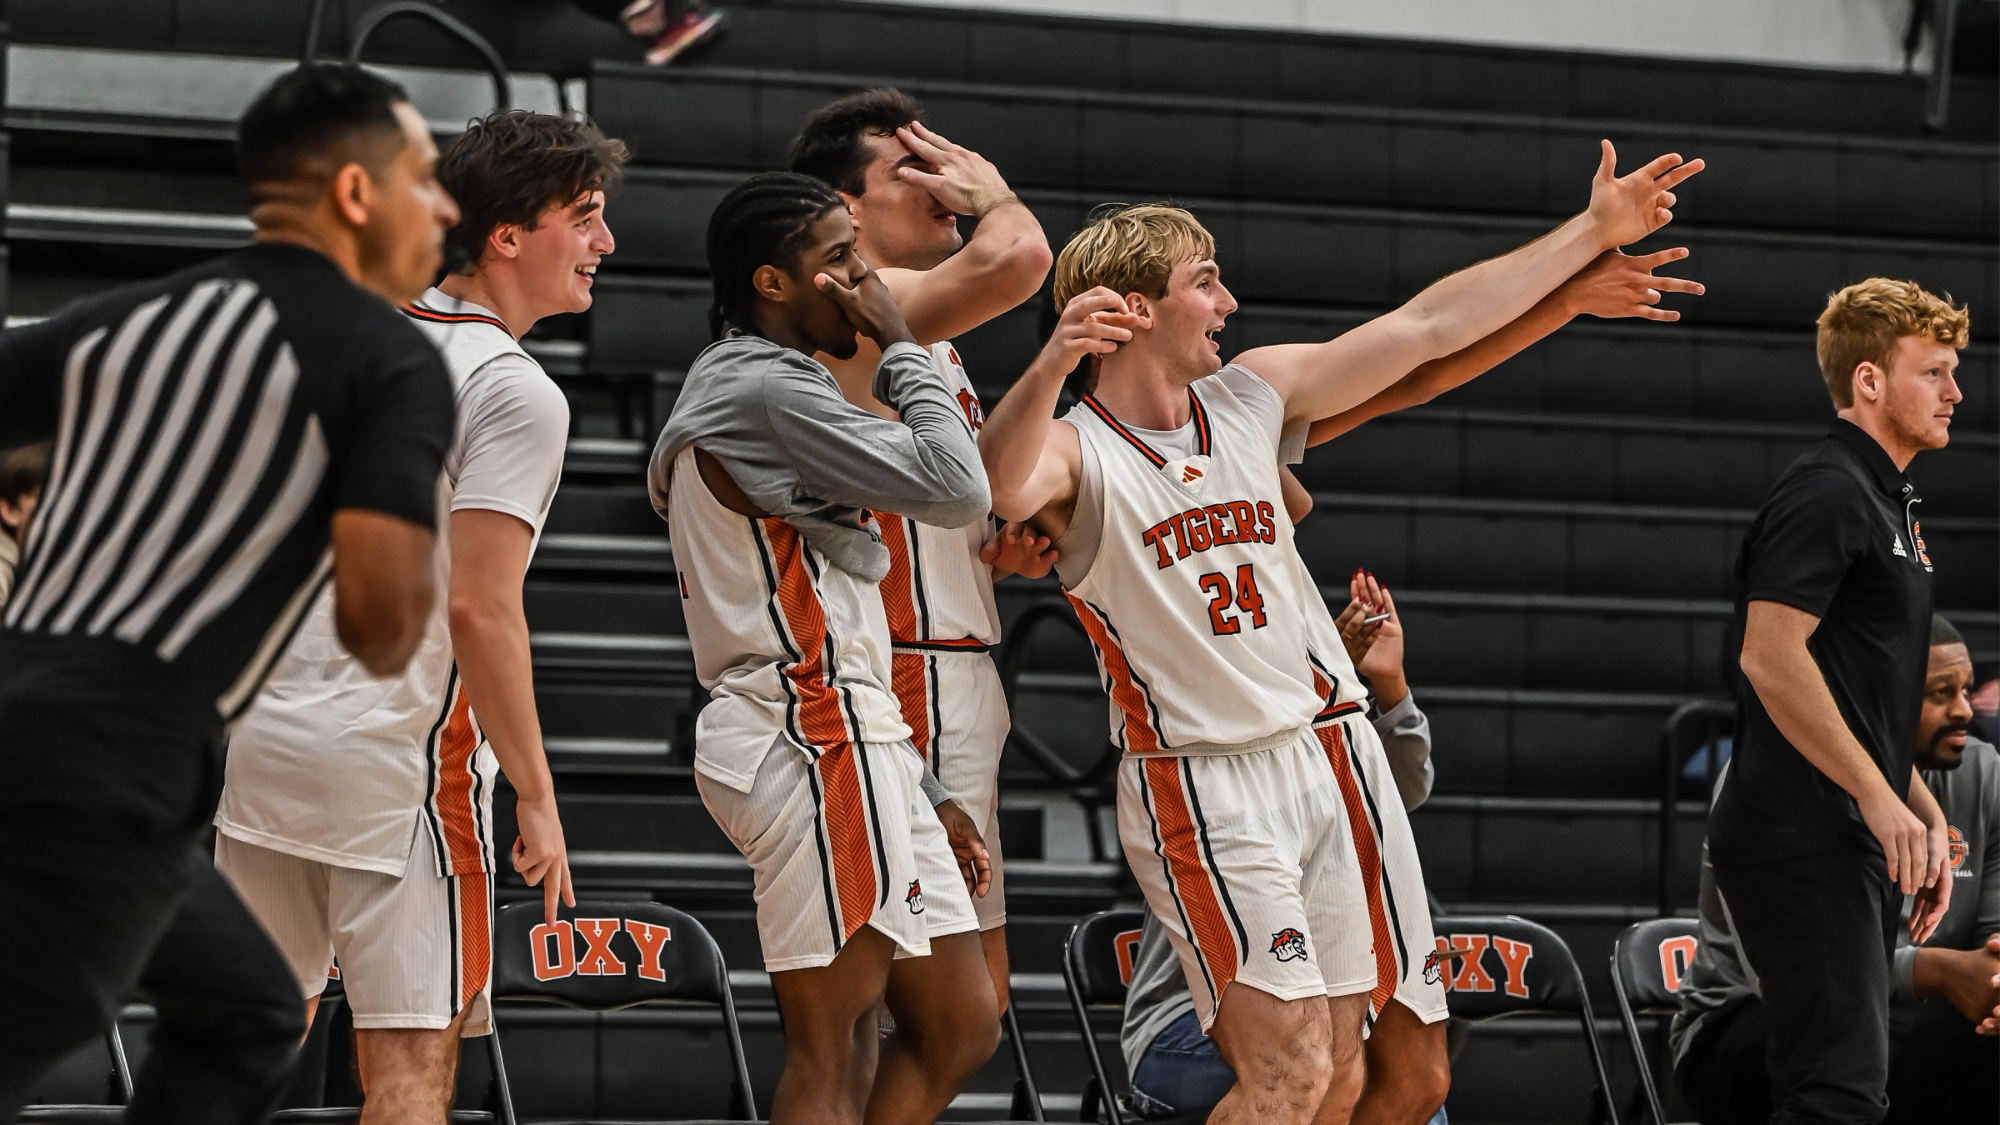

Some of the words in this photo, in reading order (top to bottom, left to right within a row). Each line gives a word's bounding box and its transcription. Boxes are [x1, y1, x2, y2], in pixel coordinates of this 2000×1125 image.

[1142, 500, 1276, 570] TIGERS
[1198, 563, 1268, 636] 24
[529, 918, 672, 983] OXY
